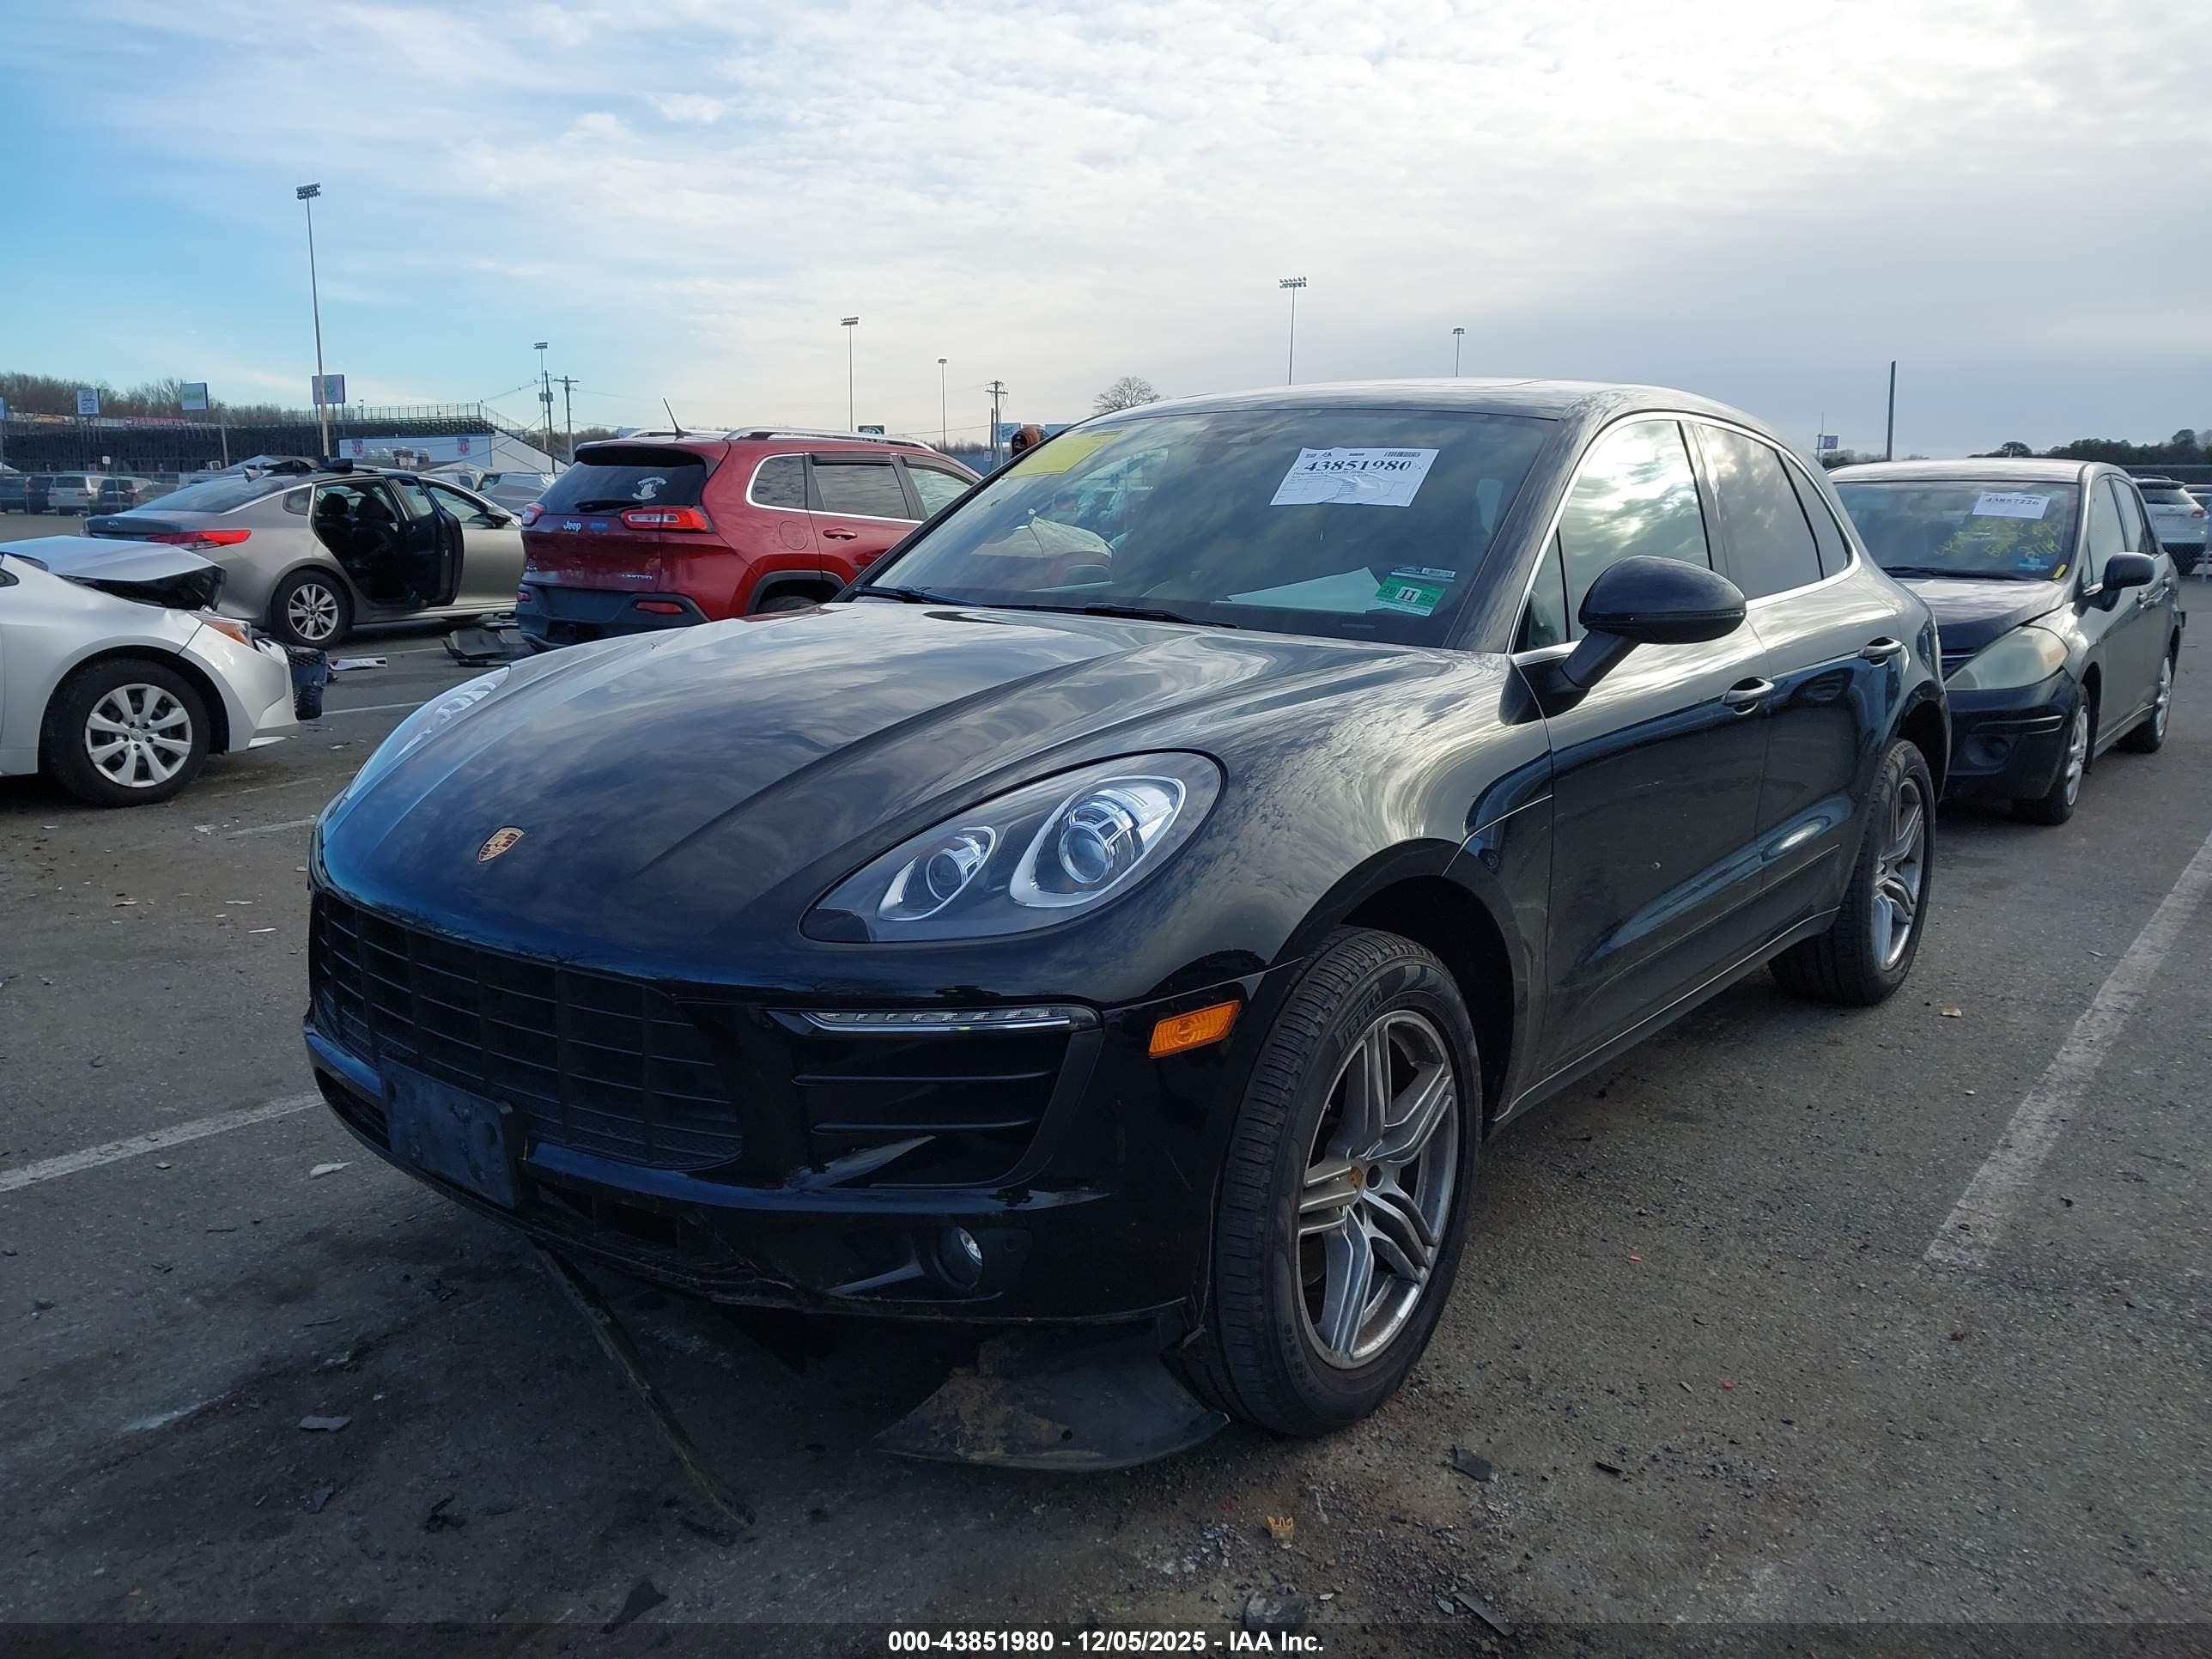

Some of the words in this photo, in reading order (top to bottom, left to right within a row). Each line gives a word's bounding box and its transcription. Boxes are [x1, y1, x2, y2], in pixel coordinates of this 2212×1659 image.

[1304, 459, 1411, 471] 43851980
[563, 520, 581, 532] Jeep
[1382, 586, 1396, 595] 20
[1400, 588, 1417, 601] 11
[1421, 593, 1436, 603] 25
